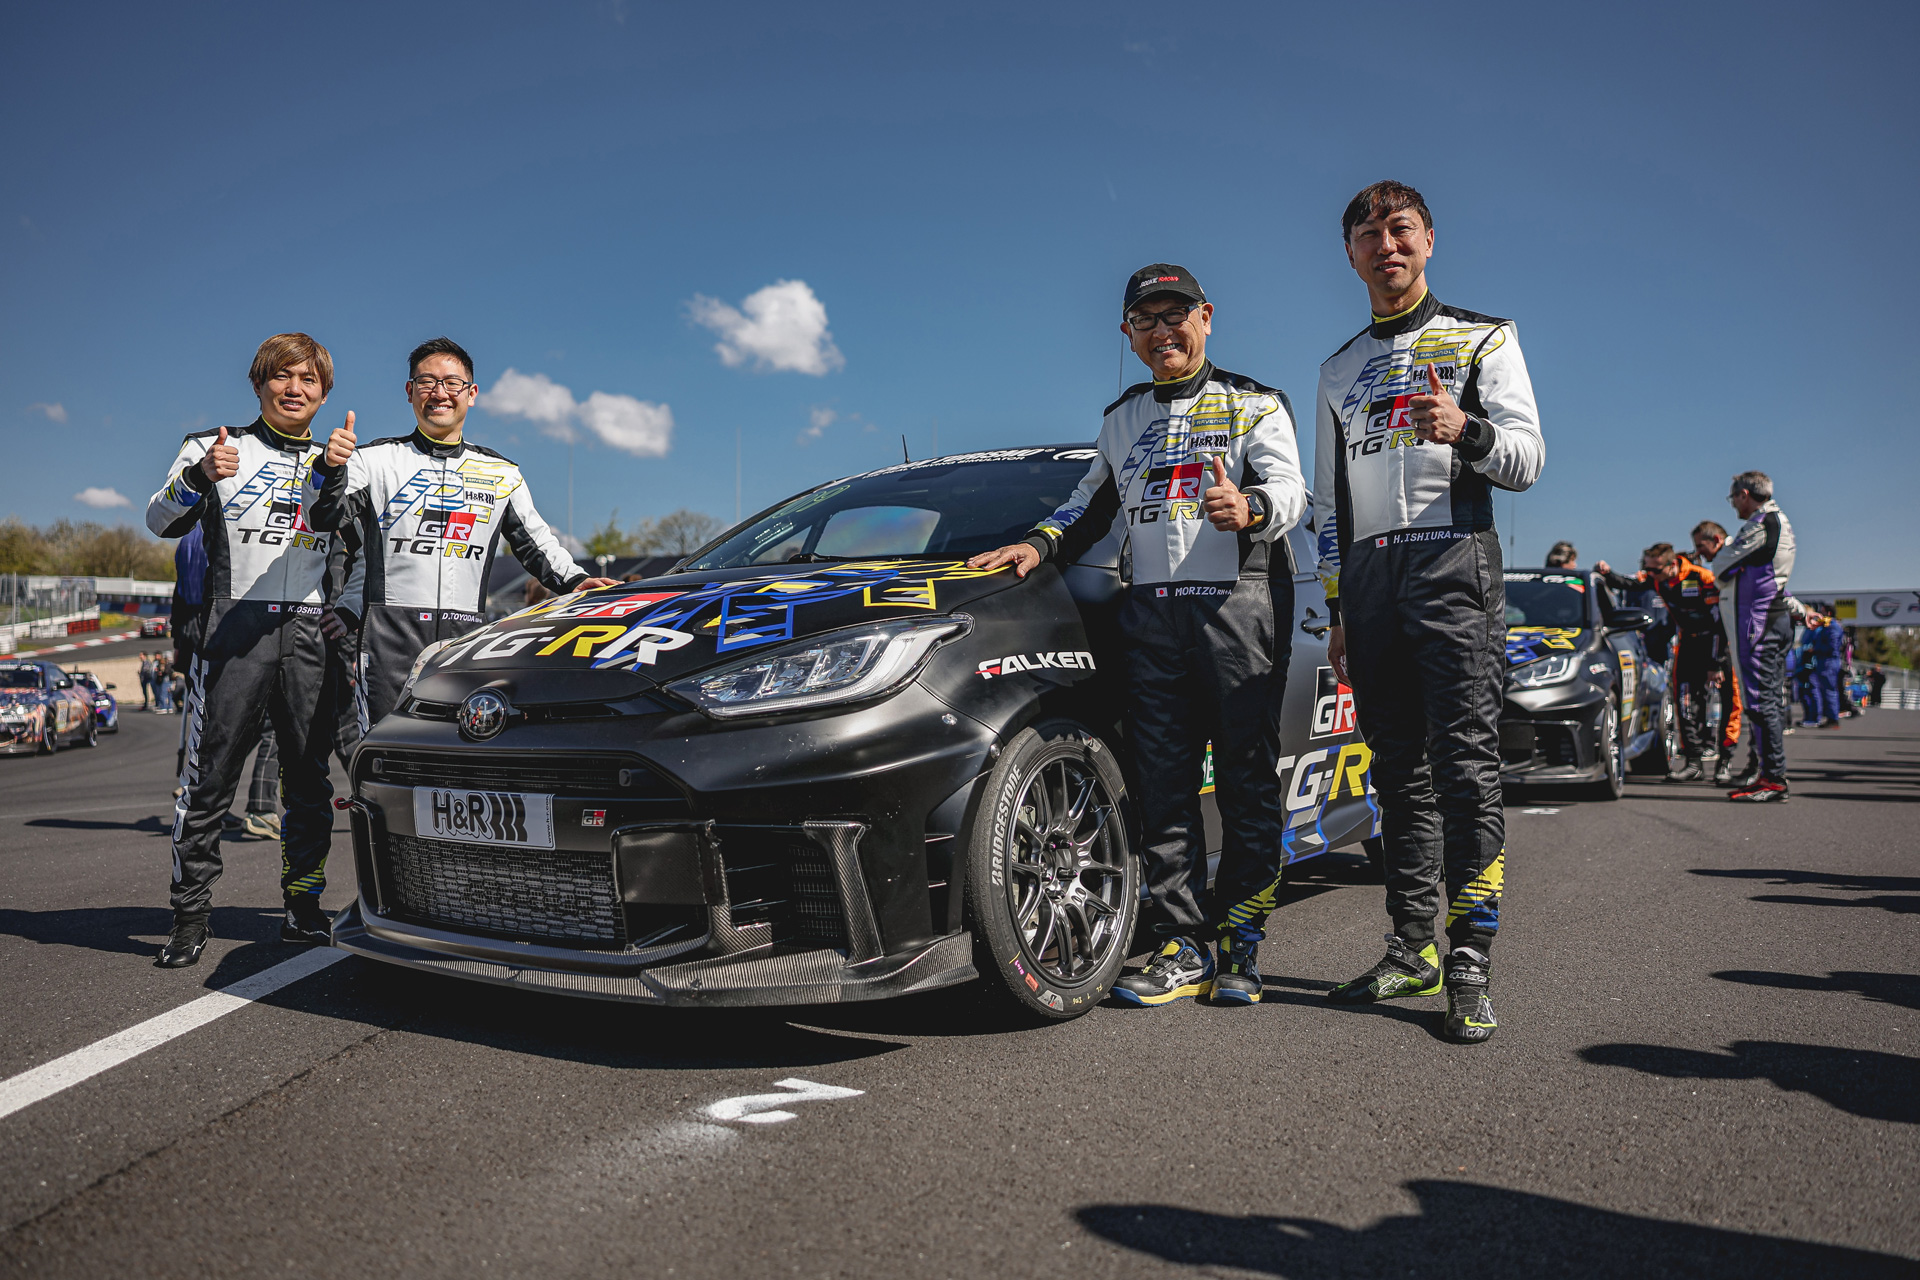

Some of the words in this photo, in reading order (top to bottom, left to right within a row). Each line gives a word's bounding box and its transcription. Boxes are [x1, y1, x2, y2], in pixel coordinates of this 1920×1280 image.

[1191, 435, 1213, 449] H&R
[465, 490, 485, 502] H&R
[1143, 477, 1199, 500] GR
[237, 528, 327, 553] TG-RR
[418, 520, 472, 540] GR
[1393, 530, 1451, 544] H.ISHIURA
[389, 537, 485, 561] TG-RR
[1175, 586, 1217, 597] MORIZO
[287, 604, 324, 615] K.OSHIM
[442, 612, 475, 622] D.TOYODA
[438, 625, 694, 669] TG-RR
[975, 651, 1097, 680] FALKEN
[1313, 692, 1357, 734] GR
[432, 789, 493, 839] H&R
[583, 816, 604, 825] GR
[992, 763, 1022, 887] BRIDGESTONE
